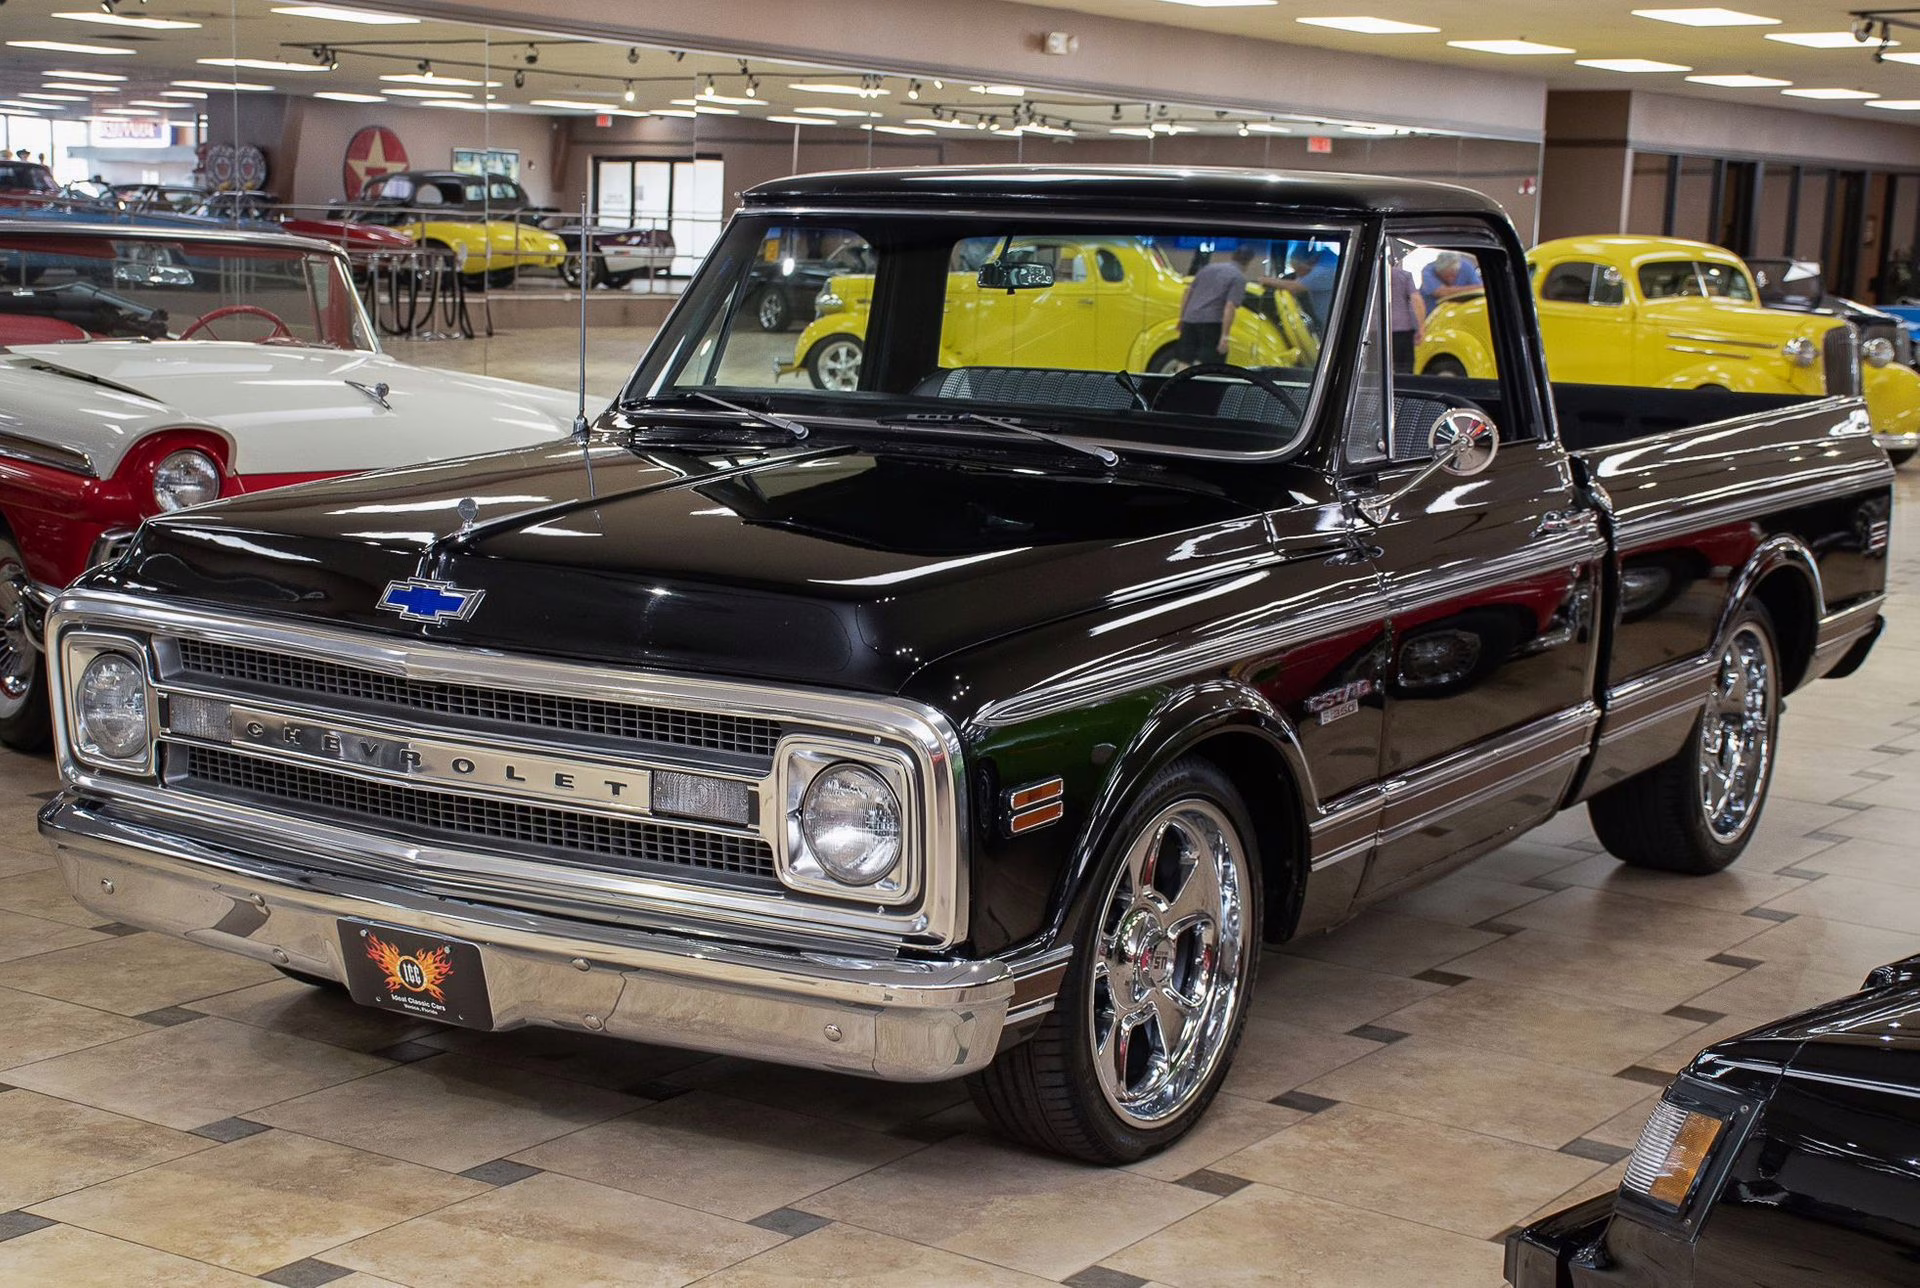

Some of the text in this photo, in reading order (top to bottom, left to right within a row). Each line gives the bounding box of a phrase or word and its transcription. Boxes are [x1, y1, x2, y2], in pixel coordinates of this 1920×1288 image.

[246, 720, 628, 798] CHEVROLET
[402, 963, 421, 985] ICC
[408, 998, 430, 1007] Classic
[431, 1002, 446, 1011] Cars
